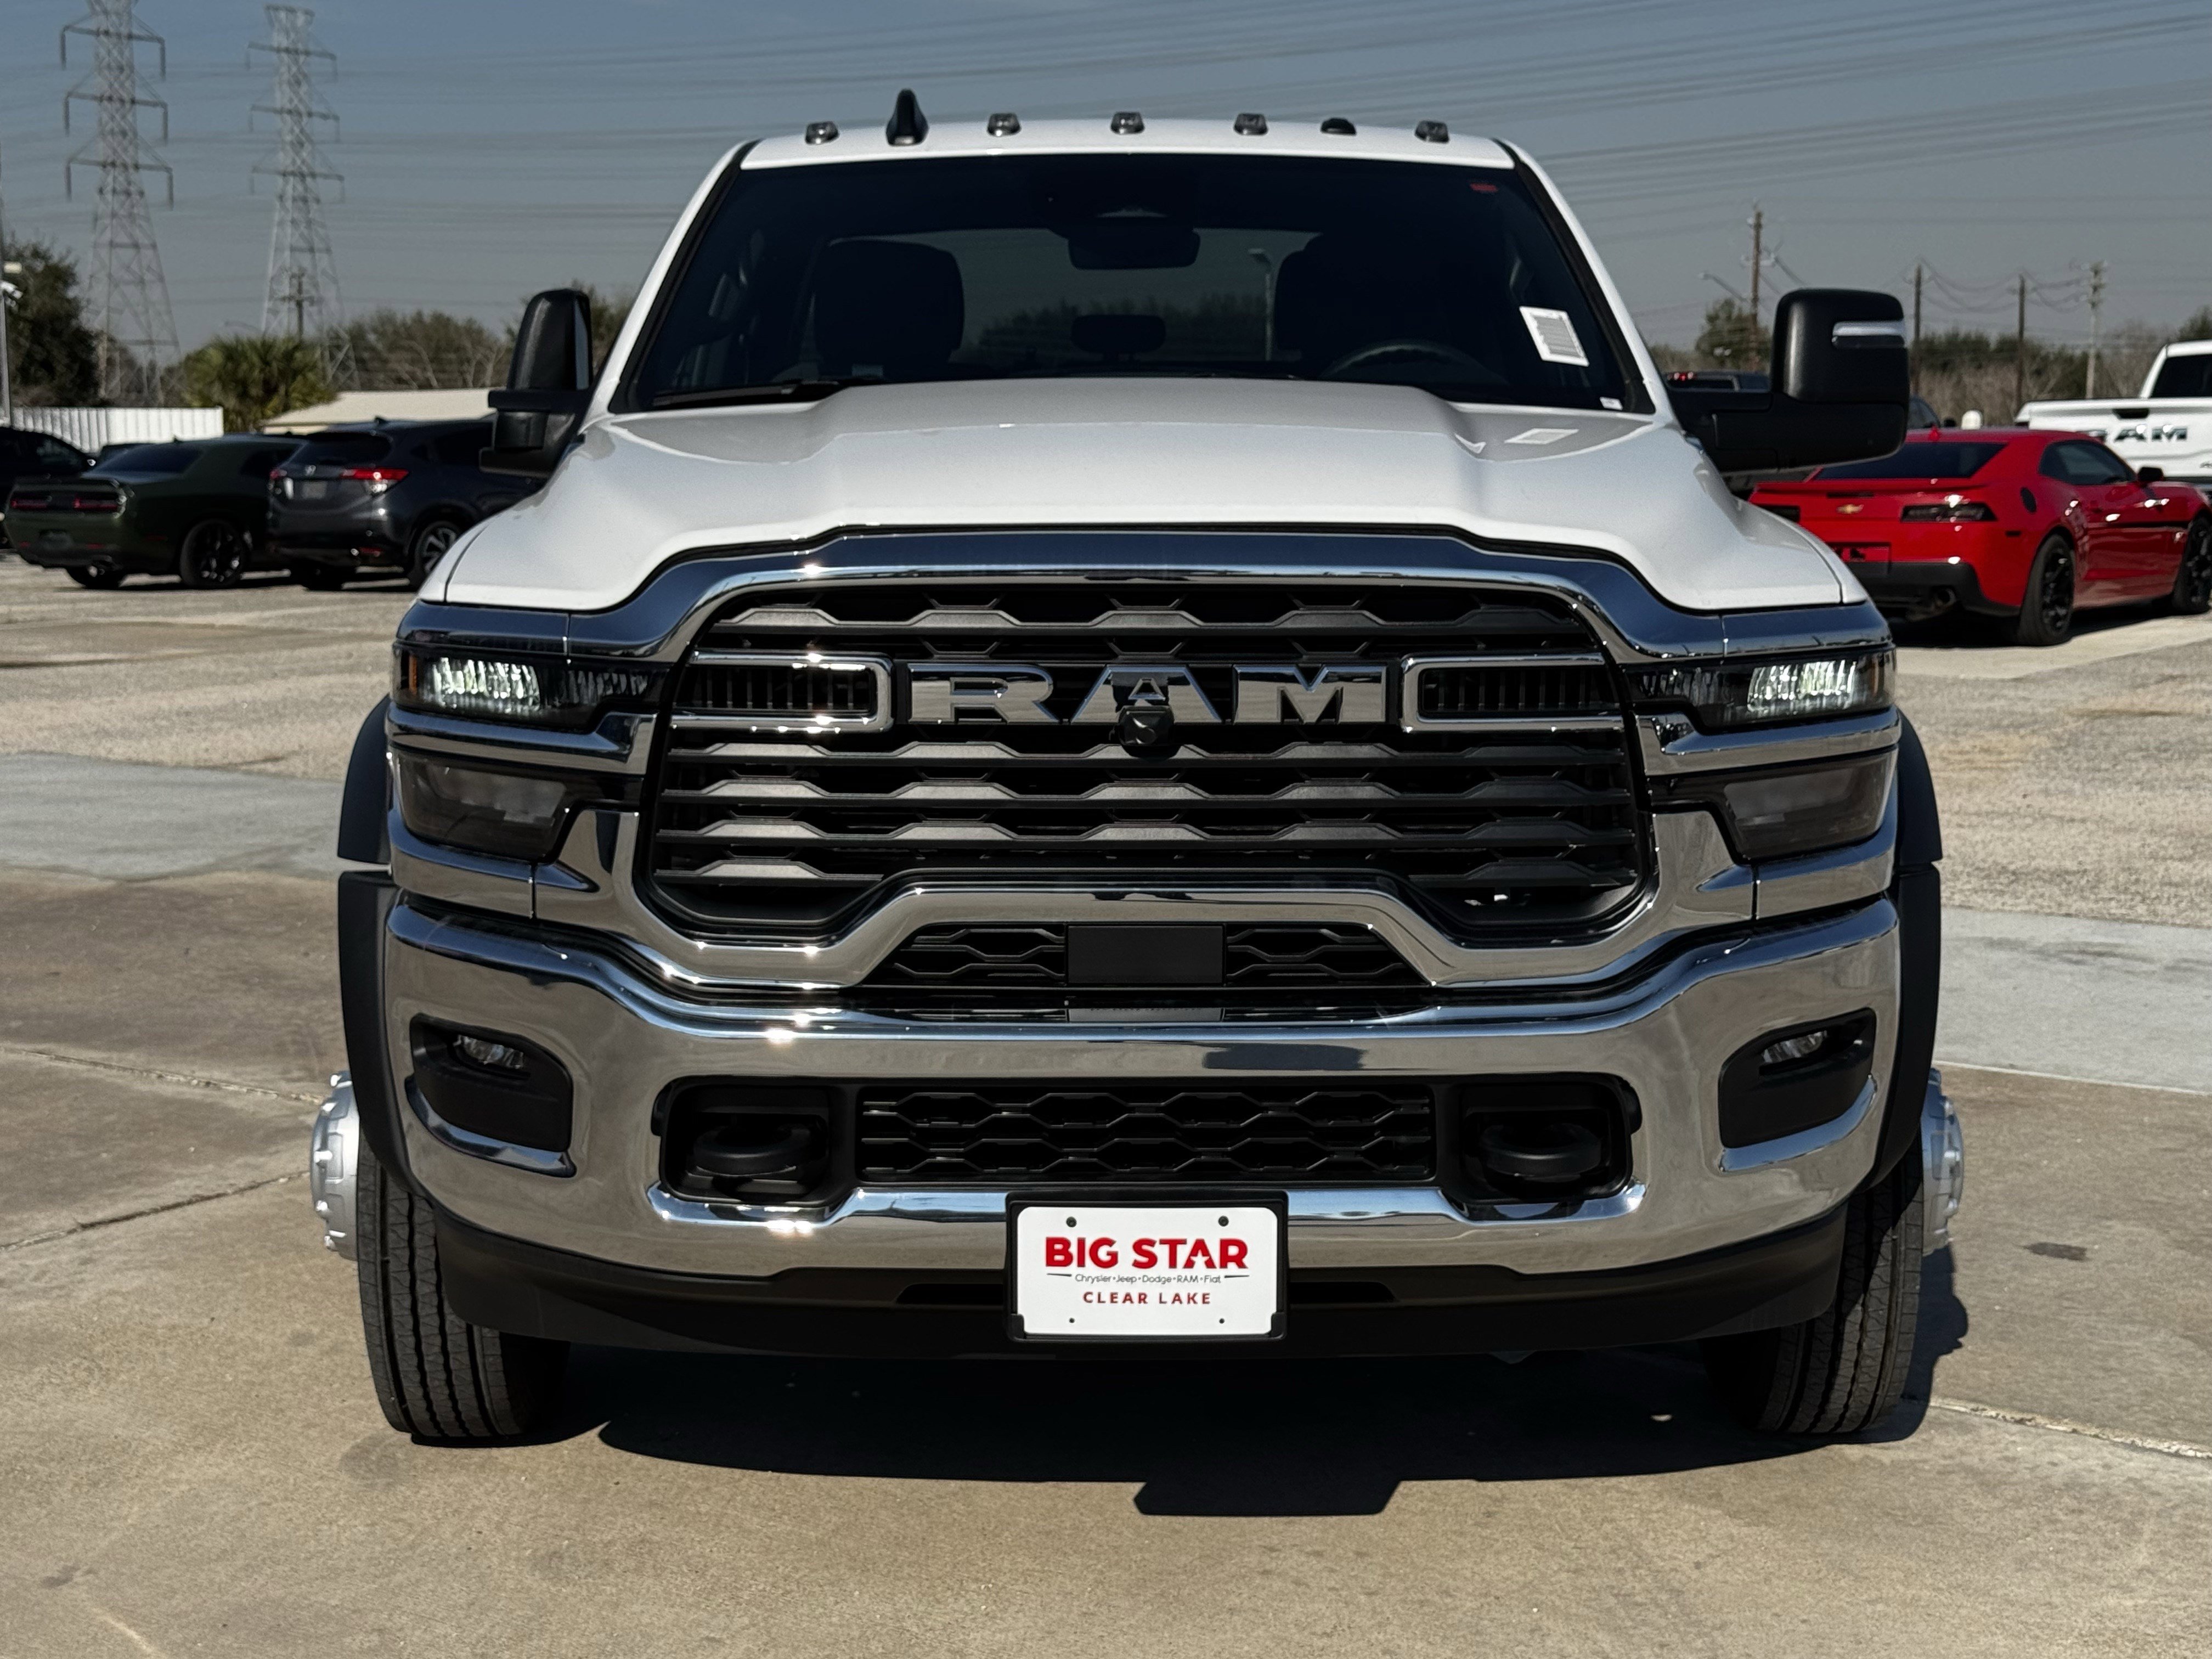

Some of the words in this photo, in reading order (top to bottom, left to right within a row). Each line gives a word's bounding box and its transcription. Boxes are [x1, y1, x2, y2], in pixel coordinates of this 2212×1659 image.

[908, 662, 1387, 725] RAM
[1046, 1237, 1119, 1269] BIG
[1132, 1237, 1249, 1269] STAR
[1083, 1291, 1148, 1304] CLEAR
[1159, 1291, 1211, 1305] LAKE
